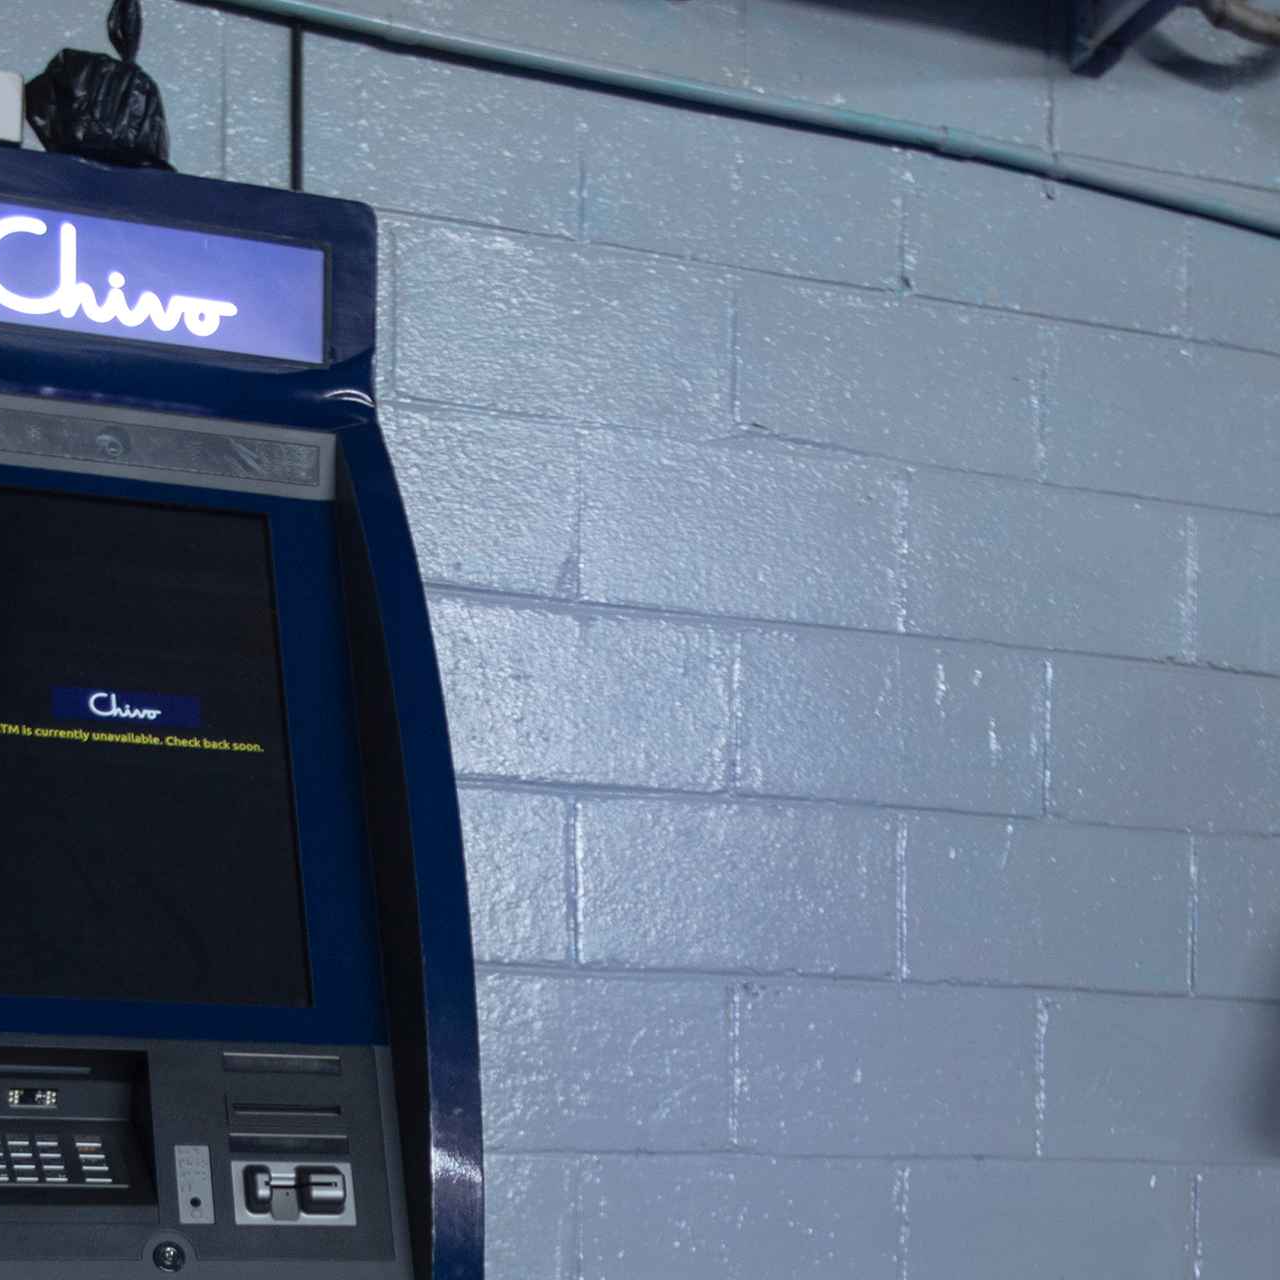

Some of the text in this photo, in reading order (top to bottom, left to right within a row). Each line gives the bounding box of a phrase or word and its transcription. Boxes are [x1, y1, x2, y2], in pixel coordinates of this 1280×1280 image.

[87, 692, 162, 720] Chivo
[22, 724, 32, 736] is
[35, 727, 89, 742] currently
[92, 730, 163, 745] unavailable.
[165, 735, 201, 748] Check
[204, 738, 230, 750] back
[232, 741, 264, 752] soon.
